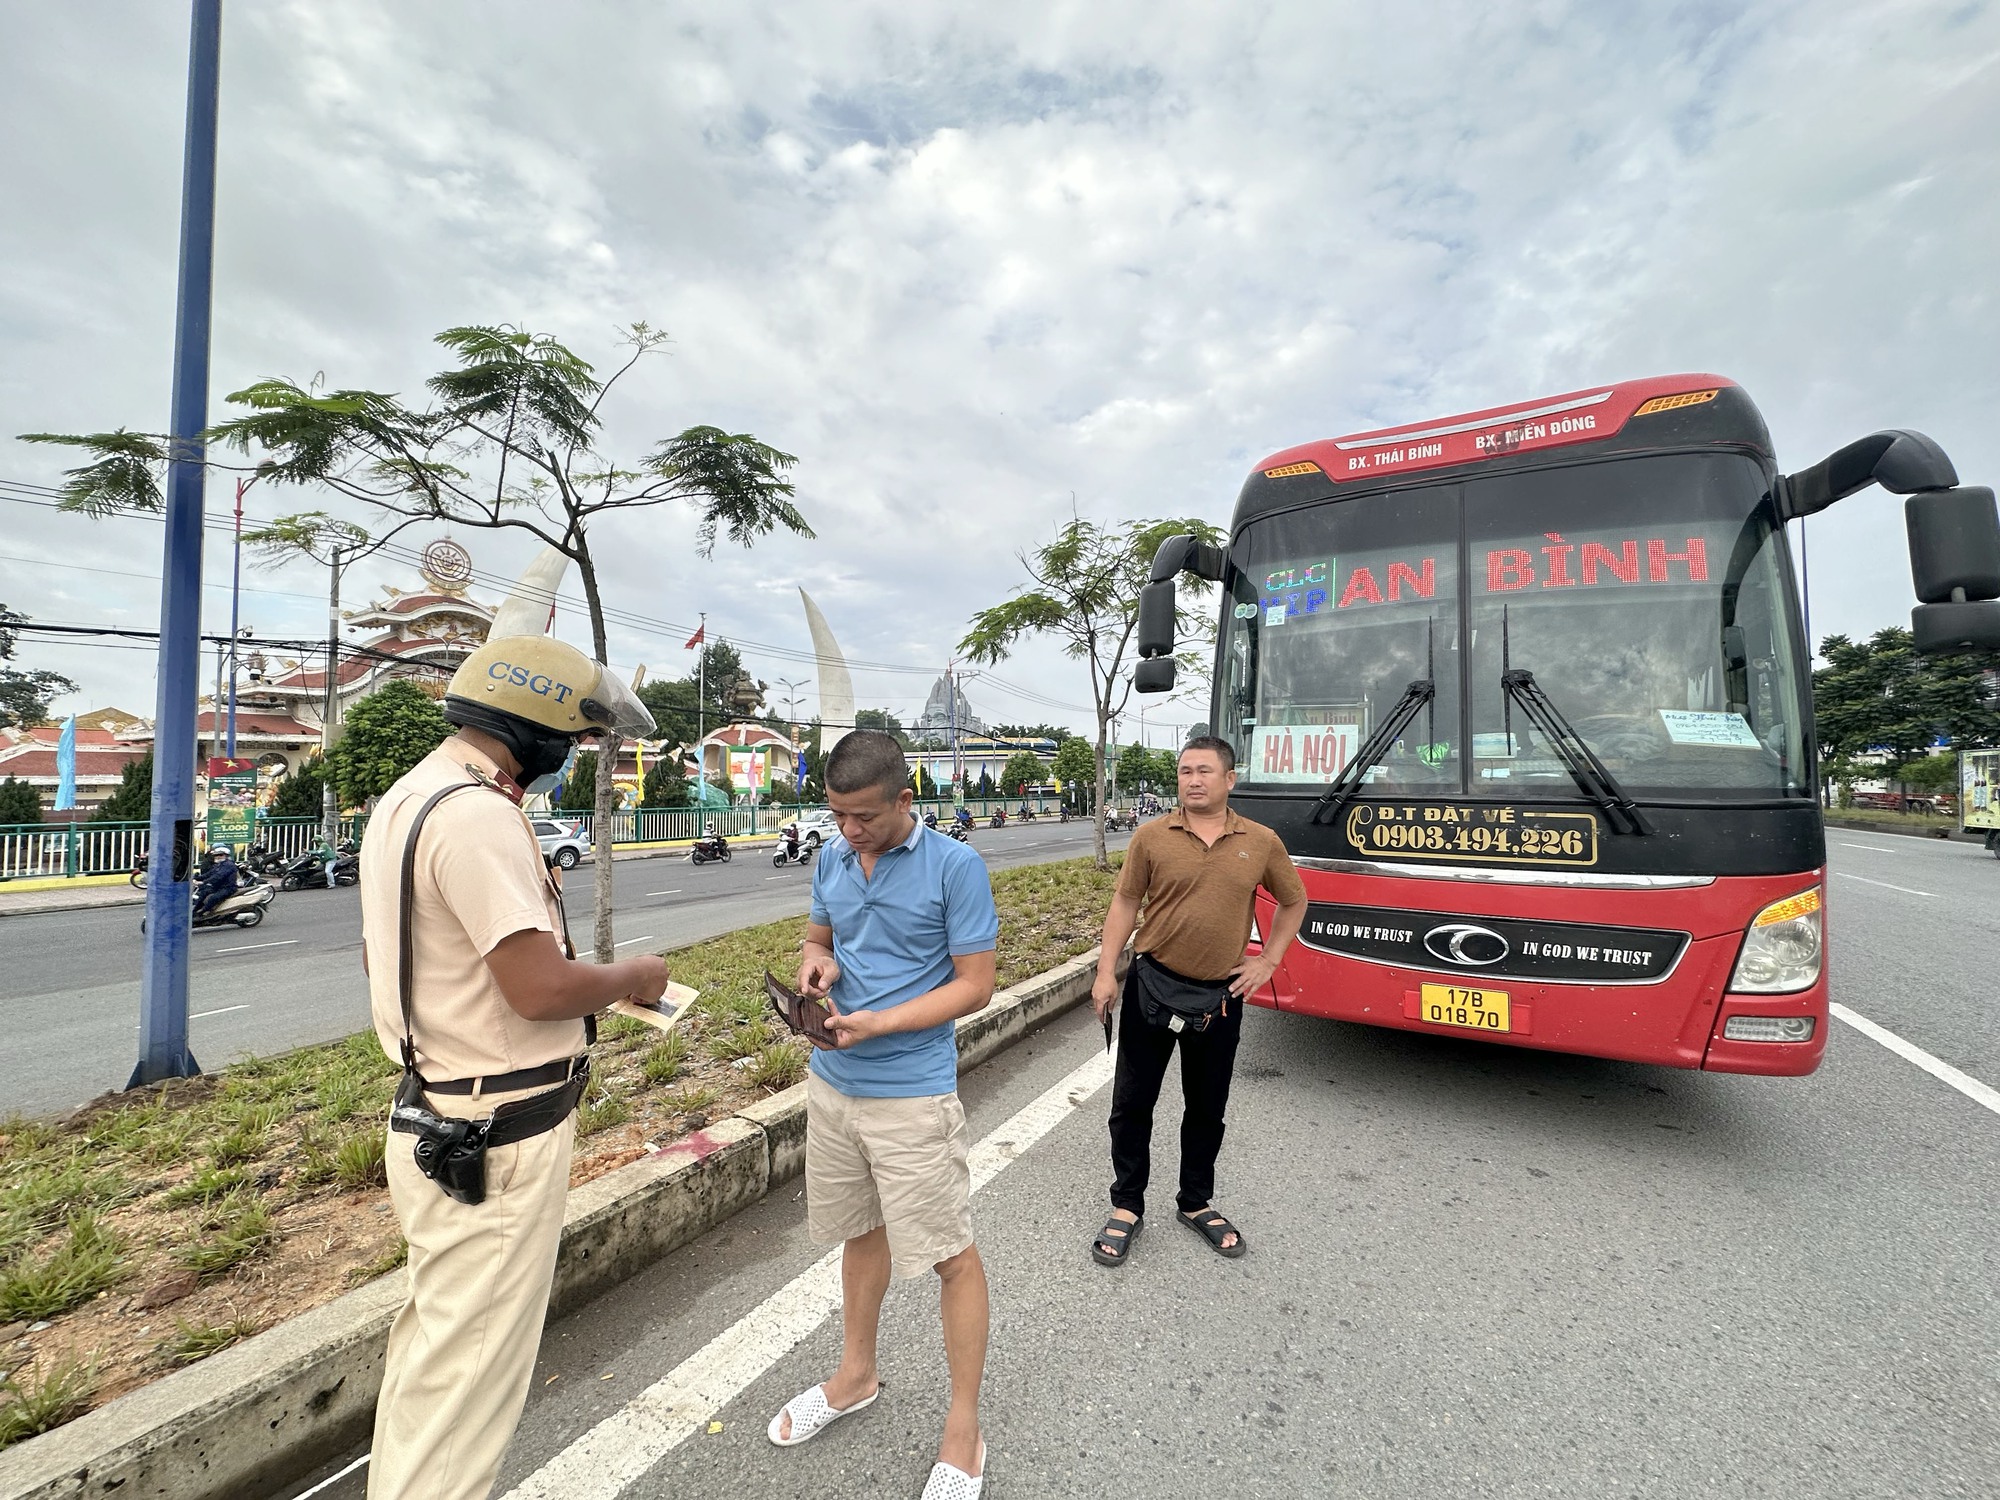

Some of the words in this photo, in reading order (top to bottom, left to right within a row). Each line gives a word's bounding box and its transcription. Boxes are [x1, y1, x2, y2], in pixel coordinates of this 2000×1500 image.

[1475, 433, 1501, 449] BX.
[1550, 414, 1596, 436] ĐÔNG
[1348, 455, 1371, 470] BX.
[1374, 447, 1404, 466] THÁI
[1265, 562, 1326, 592] CLC
[1338, 557, 1435, 608] AN
[1486, 531, 1708, 592] BÌNH
[488, 661, 574, 704] CSGT
[1263, 727, 1294, 774] HÀ
[1302, 726, 1347, 783] NỘI
[1378, 806, 1416, 821] Đ.T
[1482, 806, 1516, 824] VÉ
[1372, 824, 1584, 856] 0903.494.226
[1311, 921, 1324, 934] IN
[1326, 923, 1350, 937] GOD
[1353, 925, 1371, 939] WE
[1374, 927, 1413, 943] TRUST
[1522, 941, 1539, 955] IN
[1542, 943, 1572, 958] GOD
[1576, 946, 1599, 961] WE
[1602, 948, 1652, 965] TRUST
[1448, 989, 1483, 1007] 17B
[1431, 1005, 1499, 1028] 018.70
